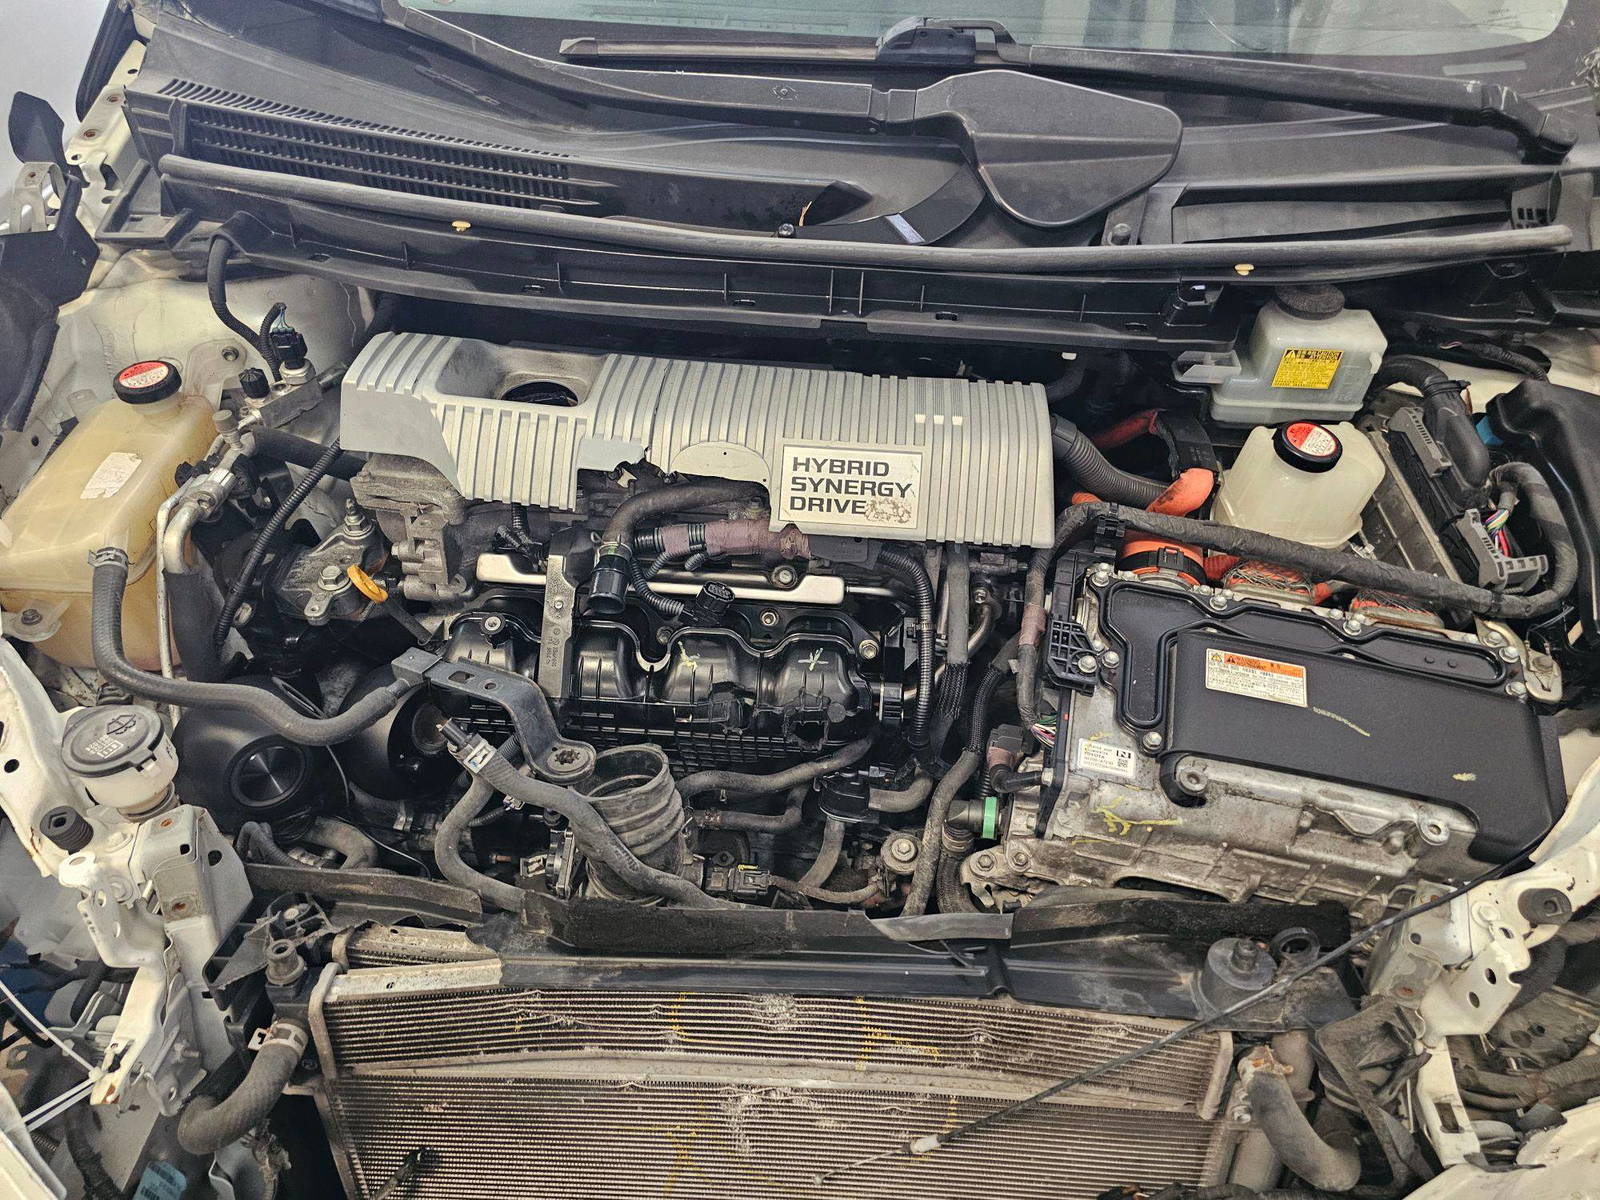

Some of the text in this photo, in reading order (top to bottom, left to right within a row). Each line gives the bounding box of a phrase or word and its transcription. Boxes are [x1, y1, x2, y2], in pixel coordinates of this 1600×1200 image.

[793, 457, 889, 477] HYBRID
[791, 477, 912, 498] SYNERGY
[790, 497, 866, 514] DRIVE
